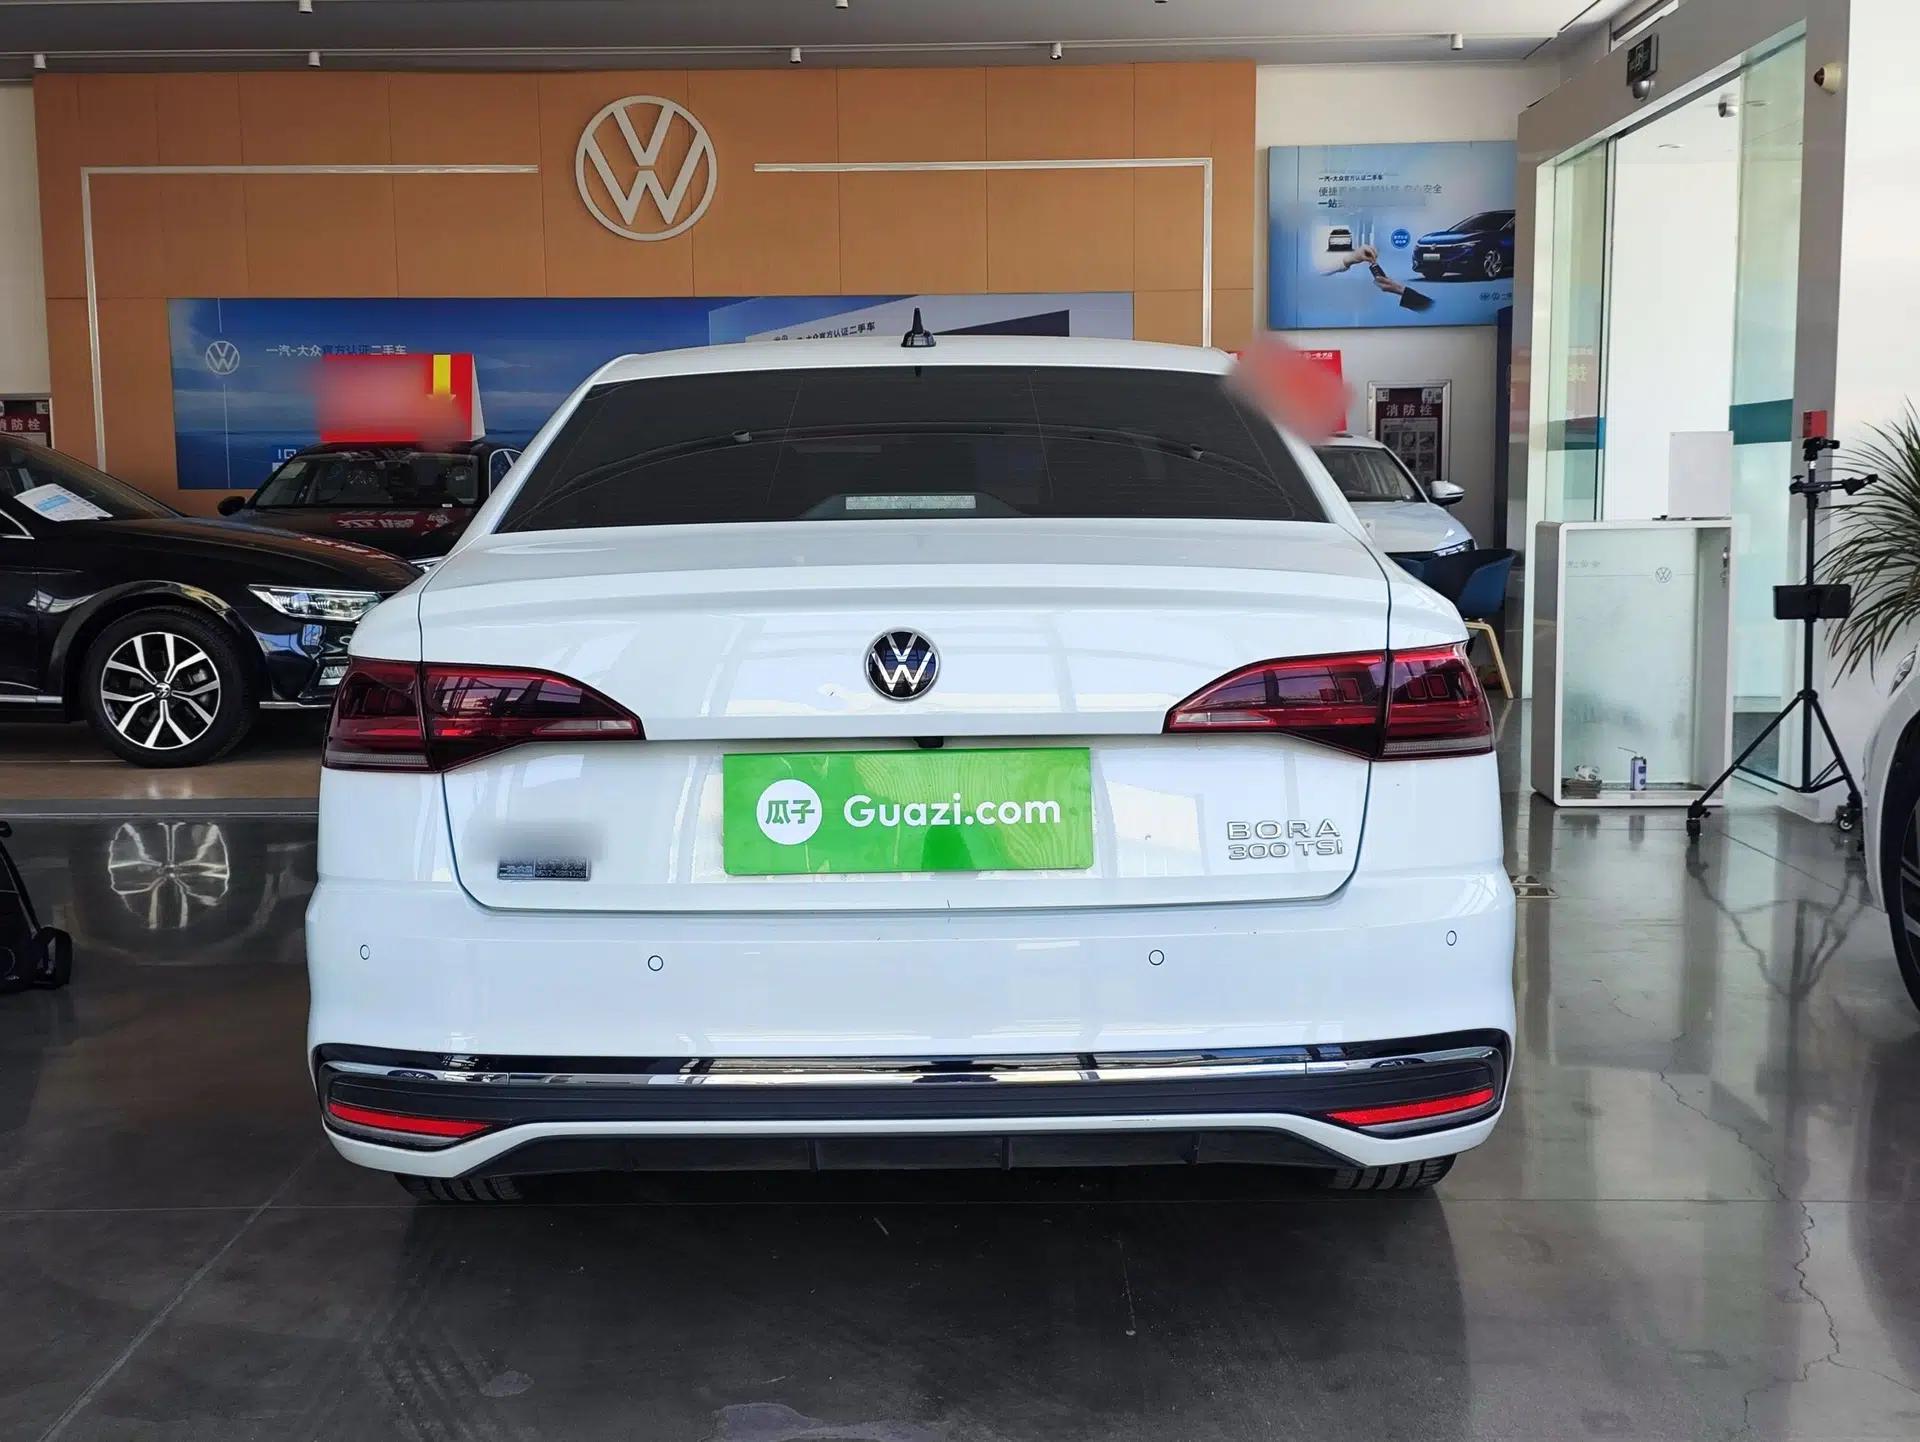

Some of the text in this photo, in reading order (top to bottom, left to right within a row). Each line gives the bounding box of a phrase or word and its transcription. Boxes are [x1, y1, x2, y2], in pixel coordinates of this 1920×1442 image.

[1386, 403, 1433, 416] 消防栓
[765, 799, 815, 825] 瓜子
[843, 792, 1061, 828] Guazi.com
[1226, 818, 1341, 840] BORA
[1228, 839, 1343, 860] 300 TSI
